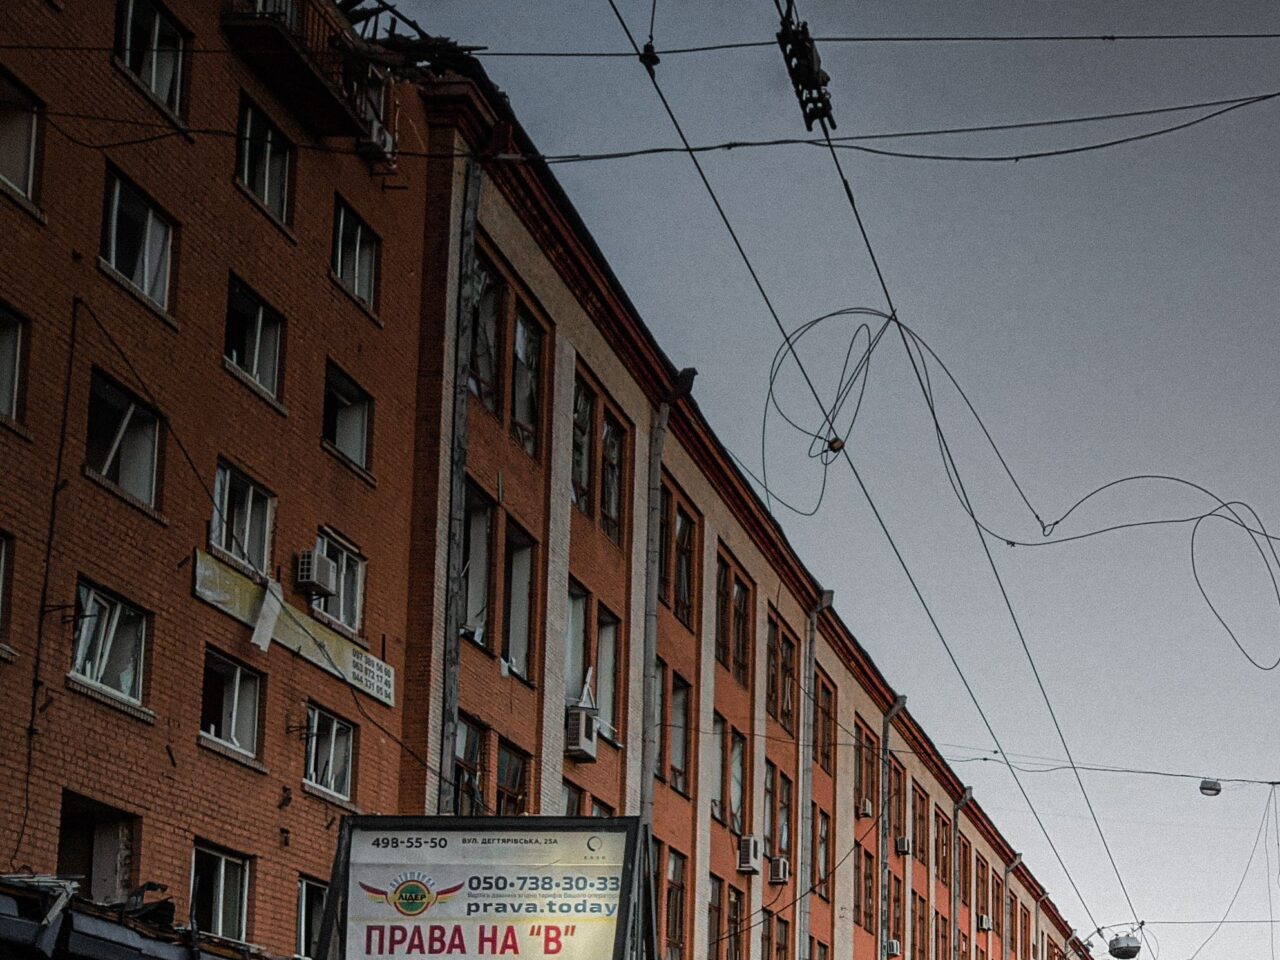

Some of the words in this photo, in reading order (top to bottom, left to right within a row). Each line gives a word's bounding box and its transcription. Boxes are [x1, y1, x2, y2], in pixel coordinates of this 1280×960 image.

[371, 836, 448, 849] 498-55-50
[466, 899, 620, 917] prava.today
[365, 925, 466, 956] ПРАВА
[478, 925, 520, 956] НА
